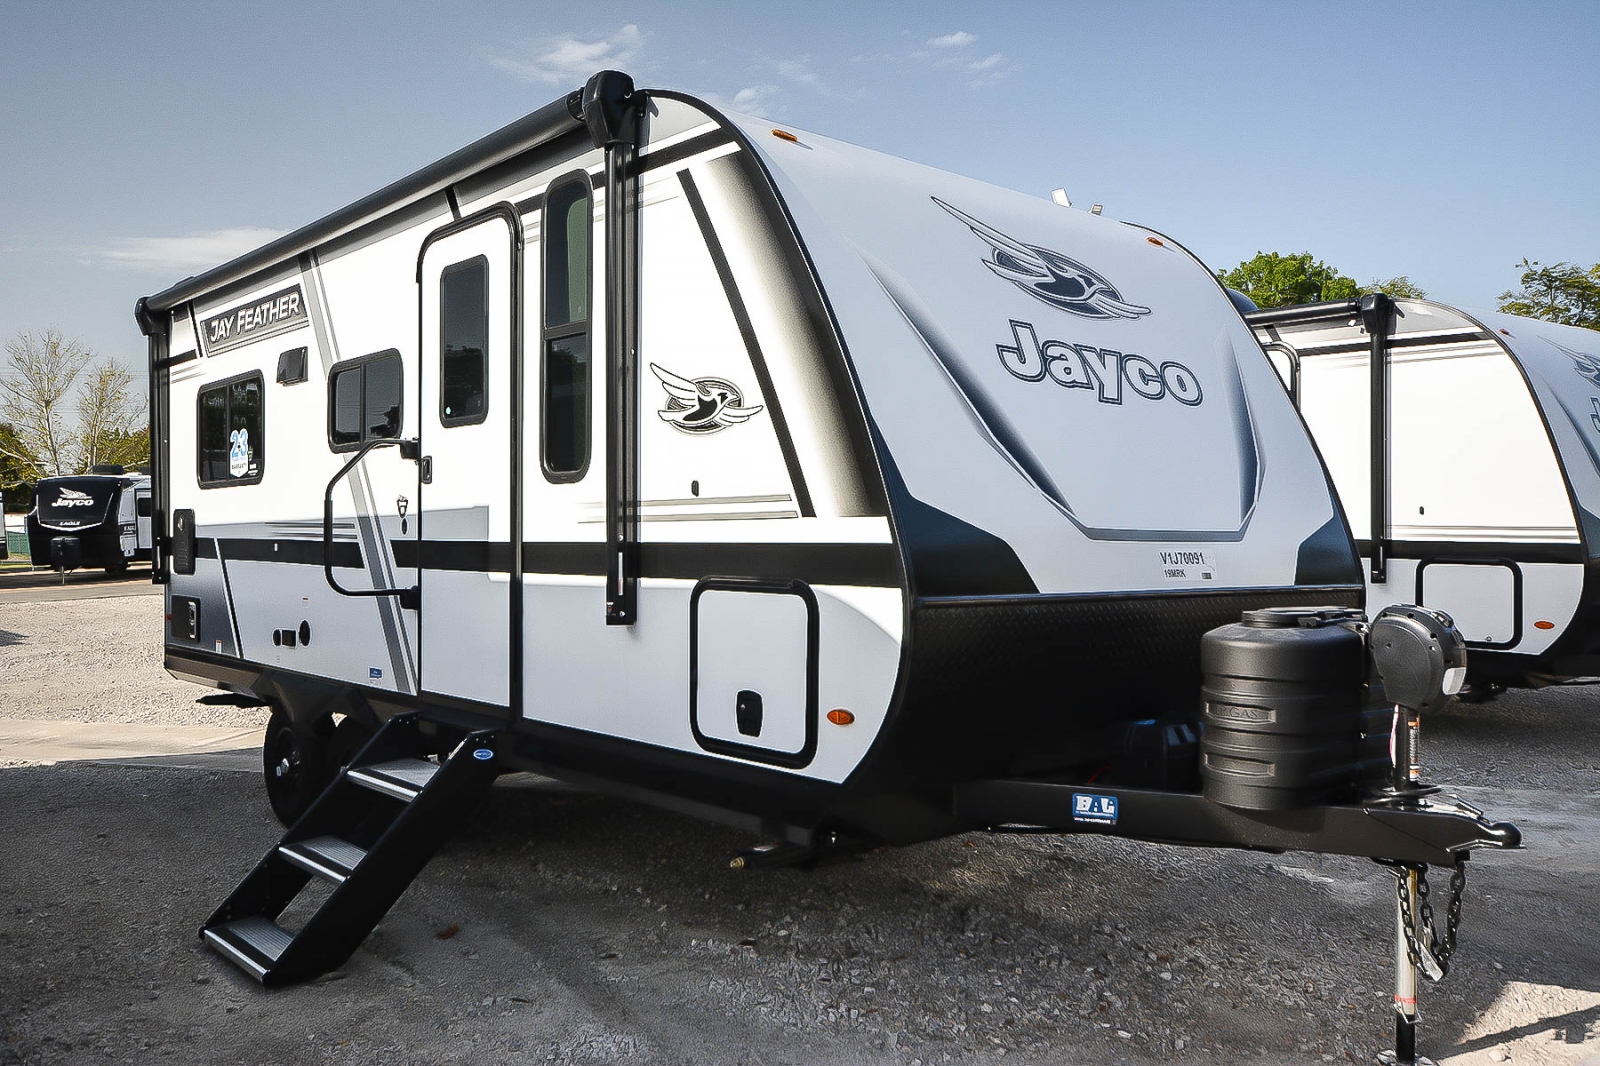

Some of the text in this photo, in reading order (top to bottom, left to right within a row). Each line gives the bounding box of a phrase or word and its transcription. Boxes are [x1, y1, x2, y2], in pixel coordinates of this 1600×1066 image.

[211, 291, 300, 343] JAY FEATHER
[996, 319, 1203, 406] Jayco
[51, 498, 94, 507] Jayco
[1160, 552, 1205, 564] V1J70091
[1076, 795, 1115, 814] BAL
